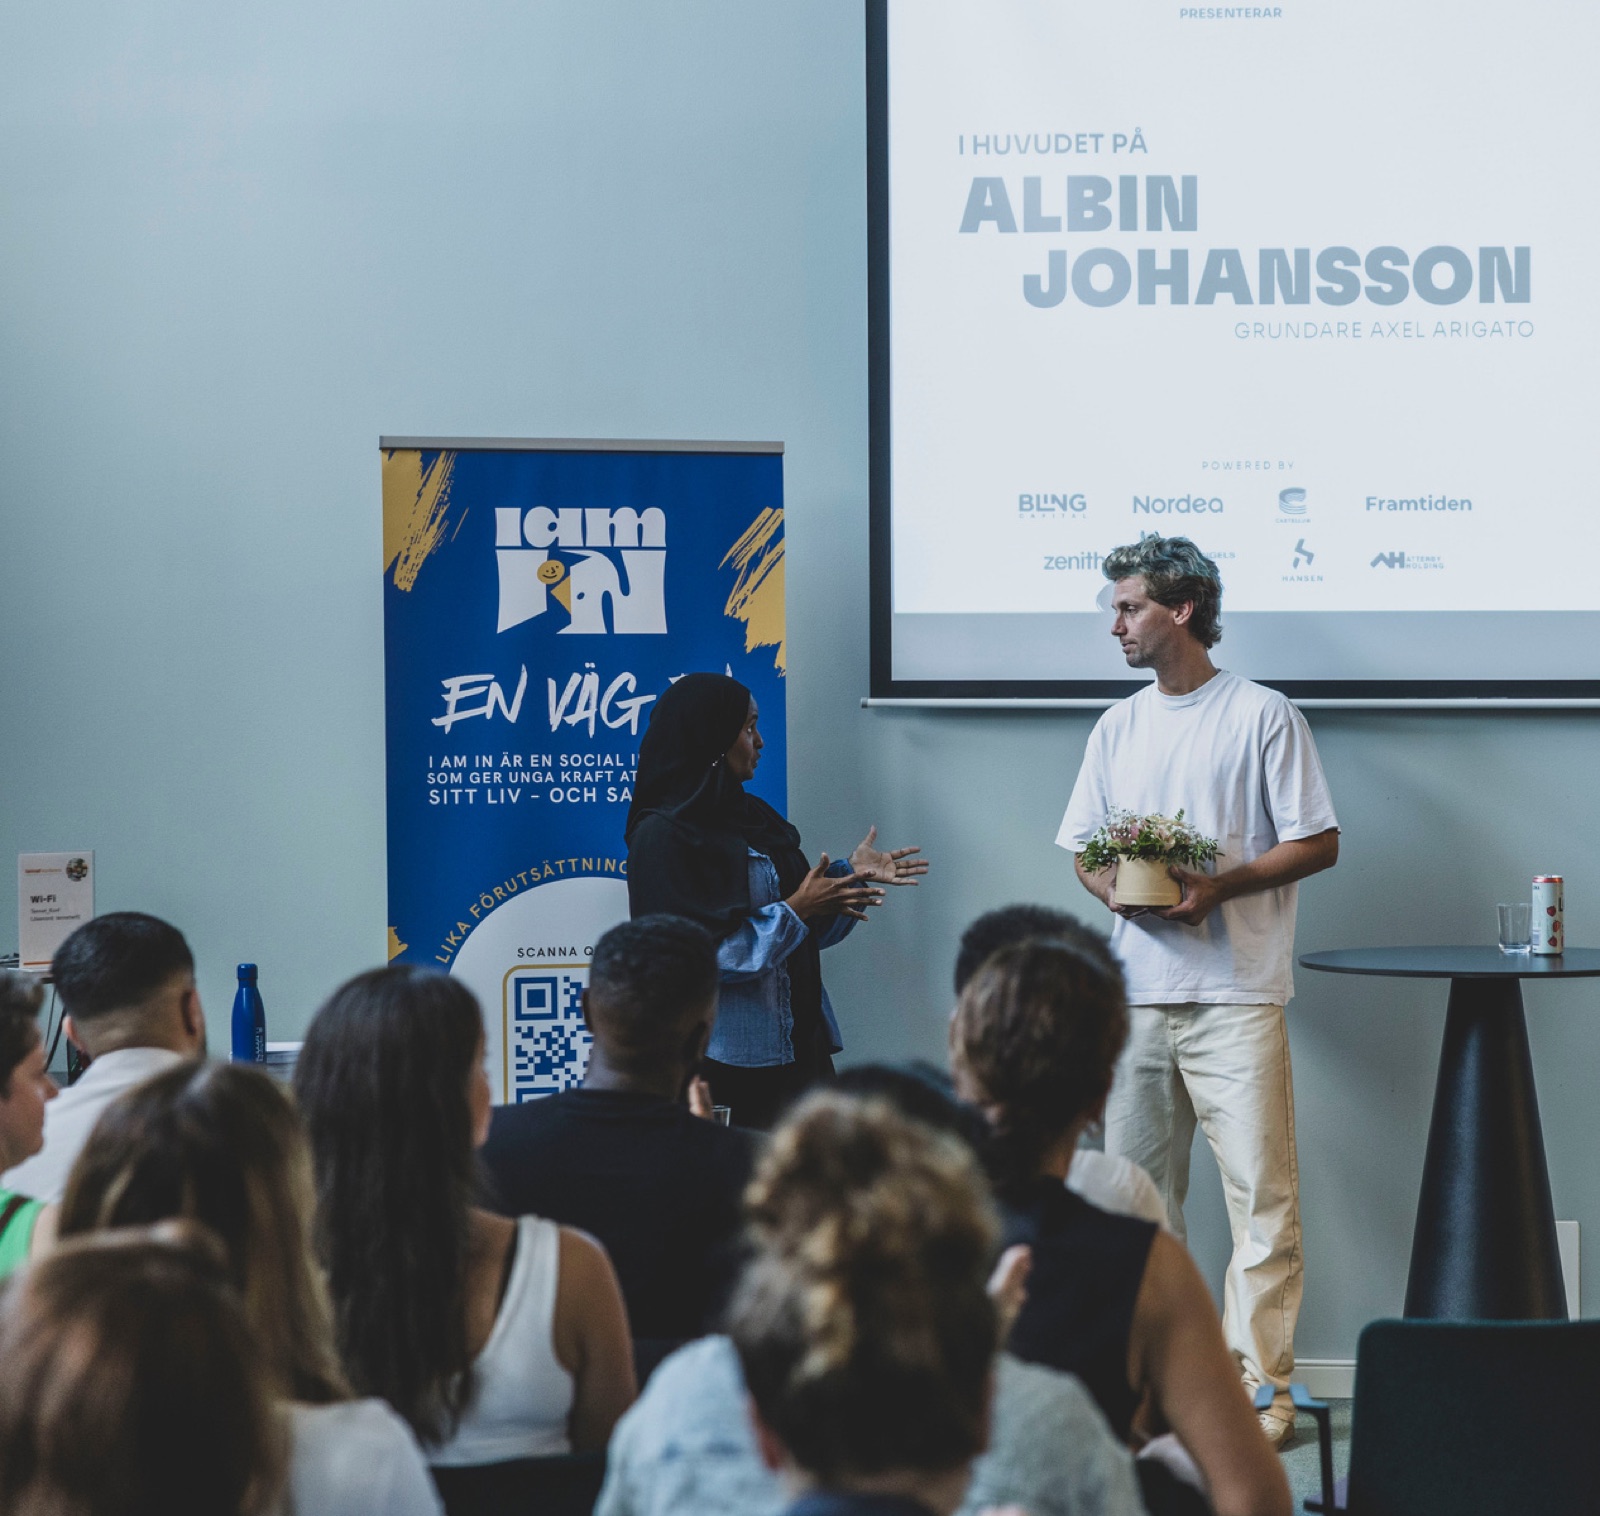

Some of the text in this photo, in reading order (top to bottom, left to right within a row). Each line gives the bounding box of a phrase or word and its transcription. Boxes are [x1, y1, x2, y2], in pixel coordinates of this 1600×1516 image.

[1179, 7, 1283, 19] PRESENTERAR
[958, 127, 1148, 156] I HUVUDET PÅ
[958, 174, 1198, 234] ALBIN
[1022, 245, 1531, 309] JOHANSSON
[1234, 320, 1535, 339] GRUNDARE AXEL ARIGATO
[1201, 460, 1294, 471] POWERED BY
[1132, 494, 1224, 514] Nordea
[1365, 494, 1473, 512] Framtiden
[431, 664, 528, 735] EN
[547, 662, 657, 738] VÄG
[429, 755, 433, 769] I
[440, 755, 467, 768] AM
[475, 755, 493, 768] IN
[500, 752, 523, 768] ÄR
[530, 754, 552, 767] EN
[559, 753, 624, 767] SOCIAL
[427, 772, 463, 784] SOM
[469, 772, 503, 784] GER
[508, 771, 555, 783] UNGA
[561, 770, 614, 782] KRAFT
[429, 789, 478, 805] SITT
[487, 788, 522, 804] LIV
[549, 787, 597, 803] OCH
[30, 894, 57, 903] Wi-Fi
[435, 921, 471, 964] LIKA
[517, 946, 578, 958] SCANNA
